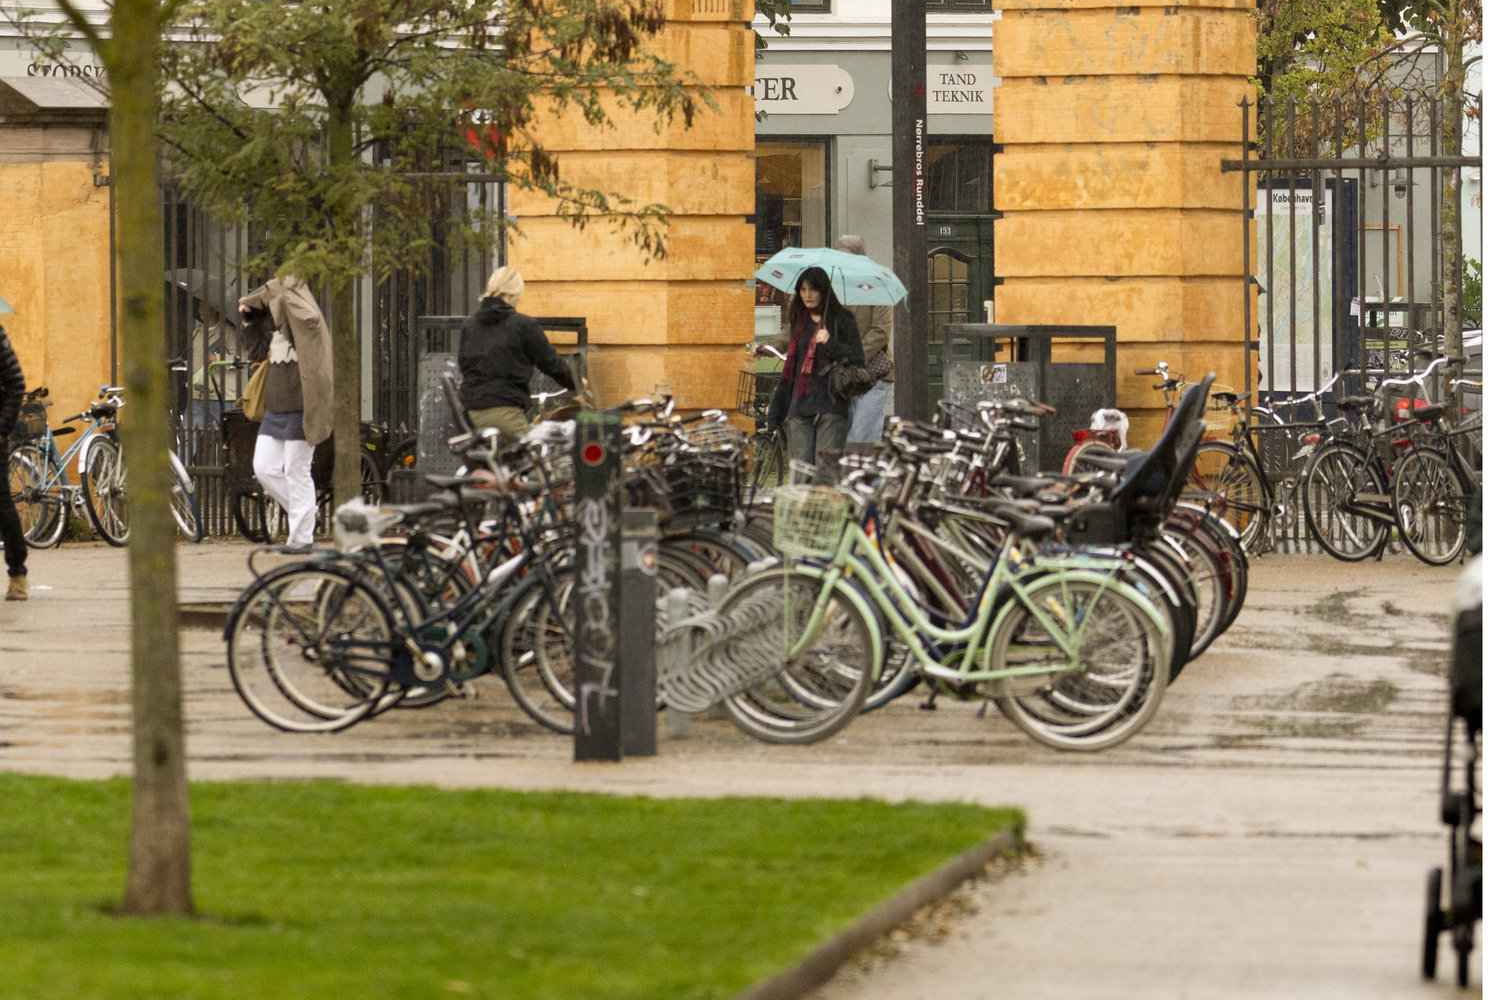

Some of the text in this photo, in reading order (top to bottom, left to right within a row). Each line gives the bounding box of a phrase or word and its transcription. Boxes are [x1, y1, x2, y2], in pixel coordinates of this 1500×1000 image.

[940, 73, 976, 86] TAND
[932, 90, 984, 103] TEKNIK
[915, 119, 924, 226] Nørrebros Runddel
[939, 226, 952, 236] 153
